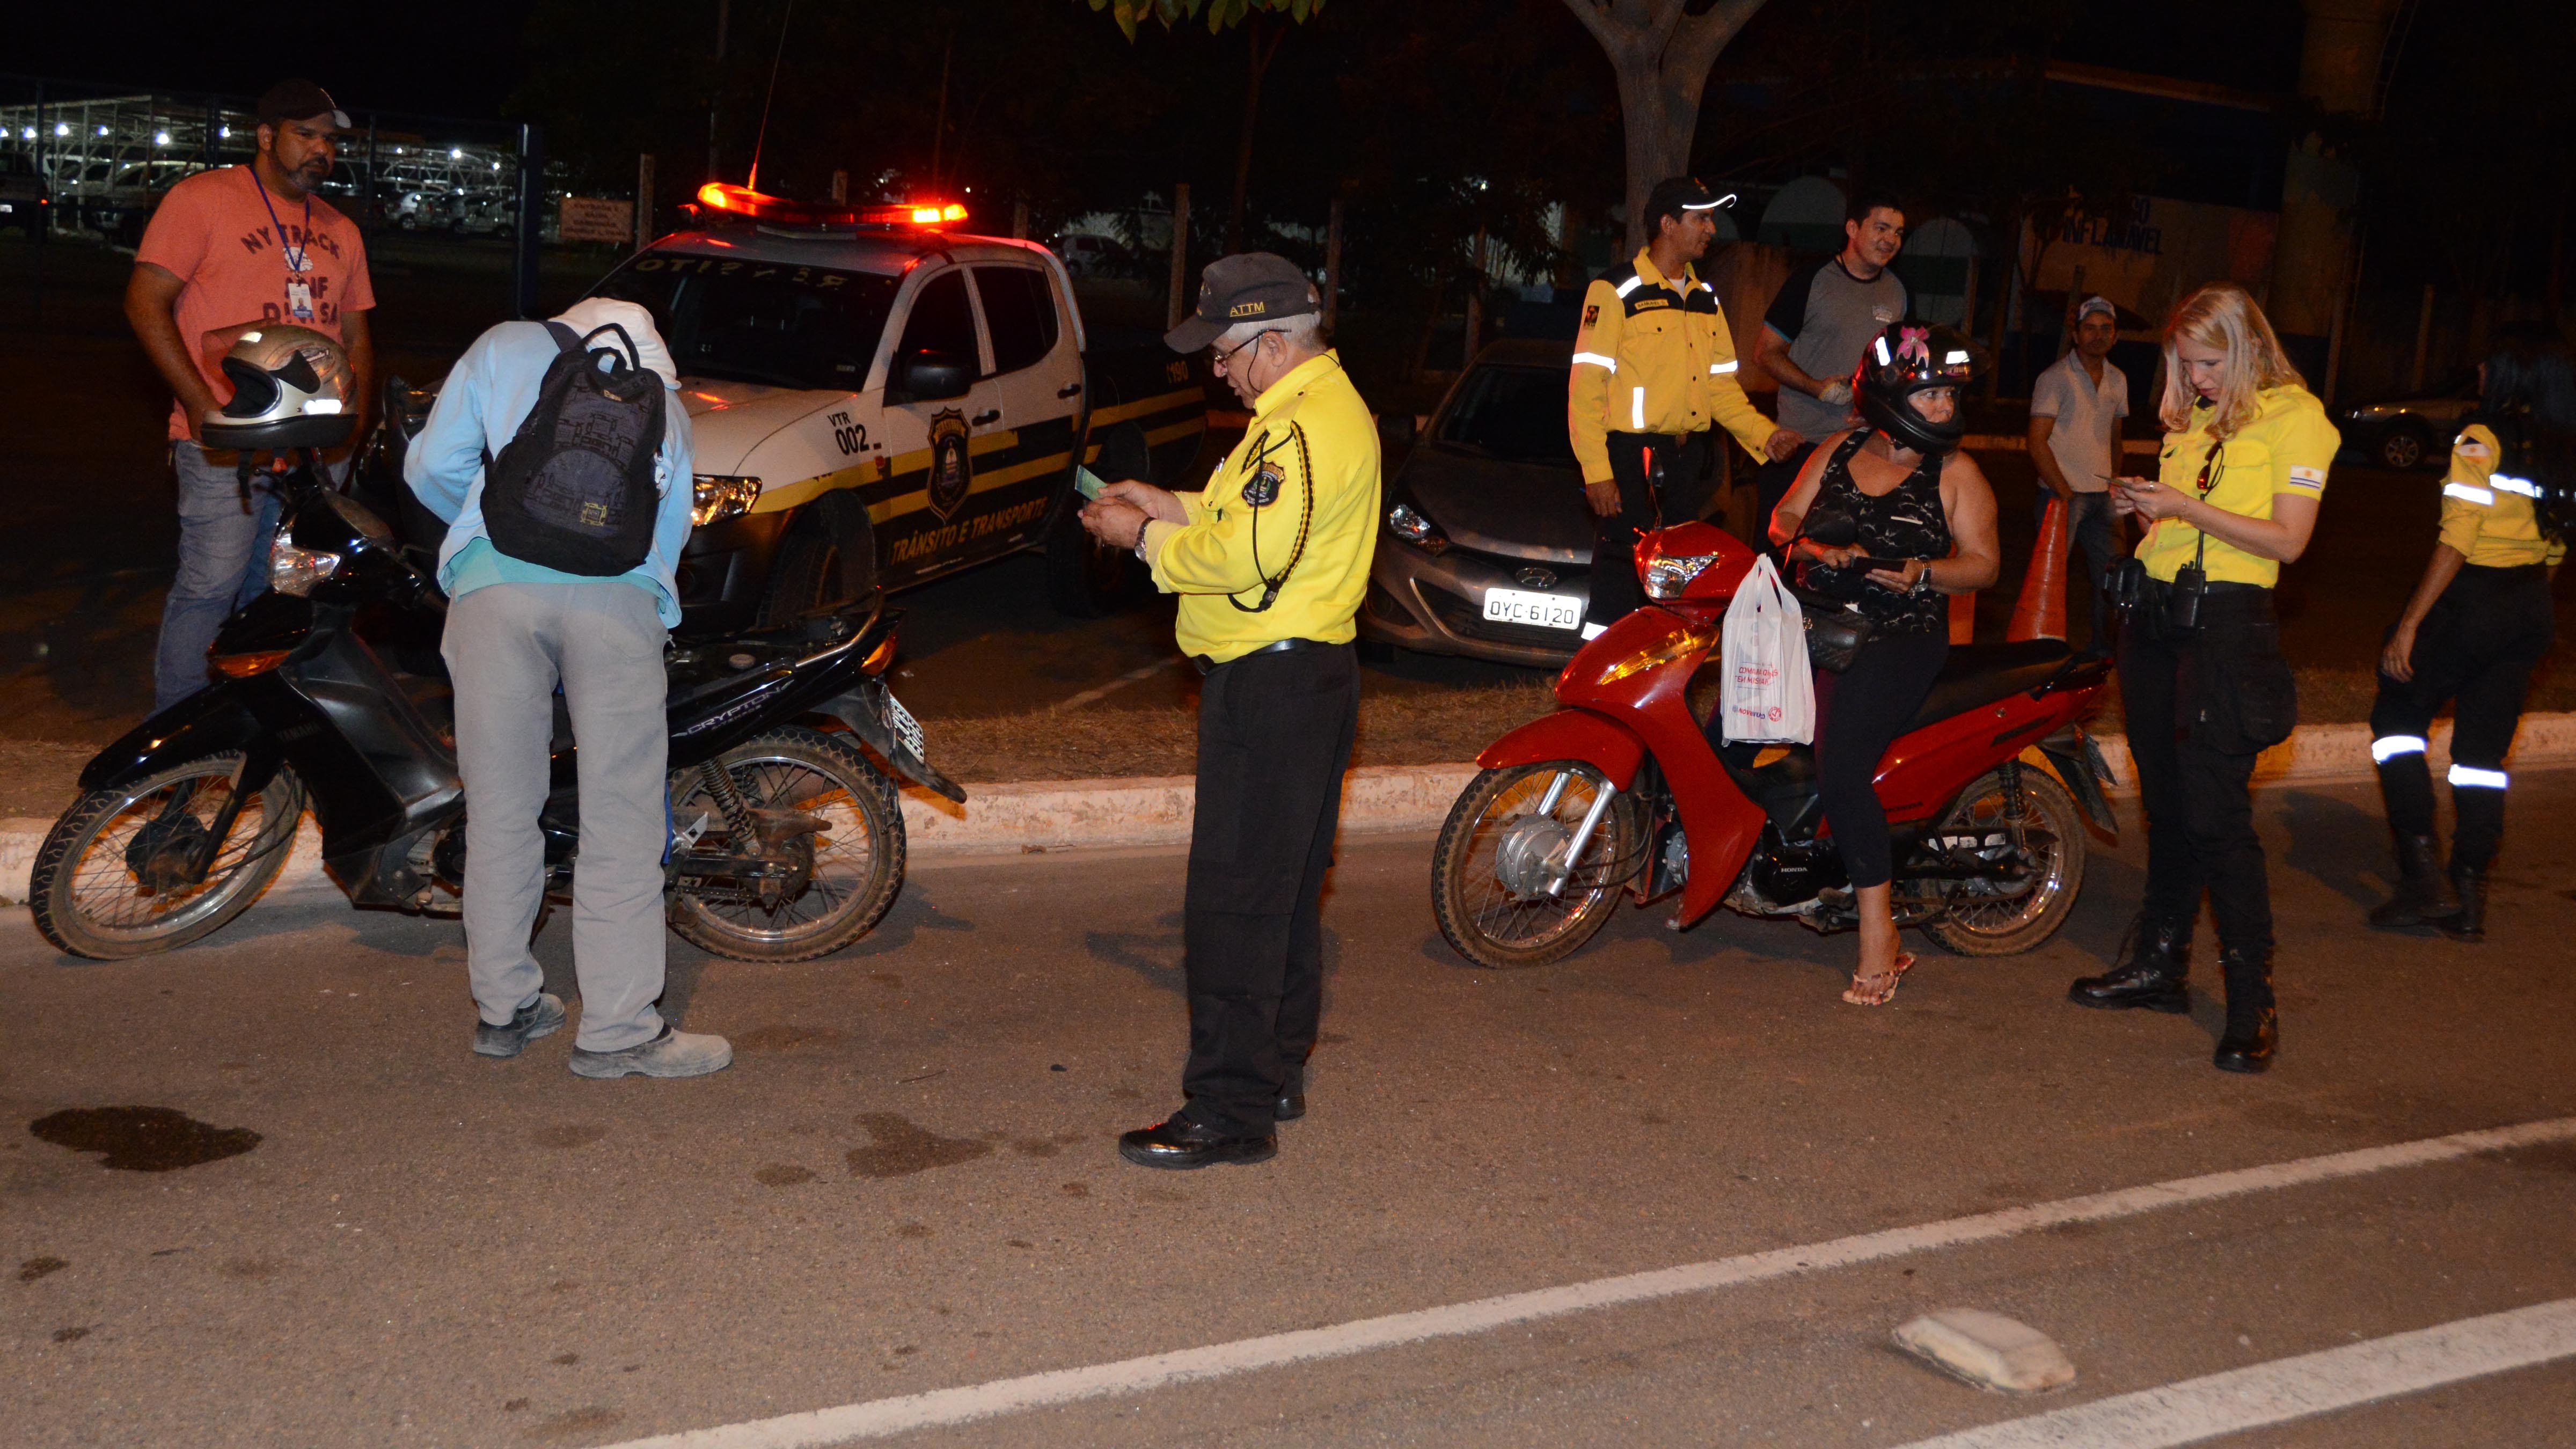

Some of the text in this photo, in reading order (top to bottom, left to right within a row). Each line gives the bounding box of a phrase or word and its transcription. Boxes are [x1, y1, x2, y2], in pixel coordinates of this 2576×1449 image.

[240, 224, 340, 260] NY TRACK
[1230, 301, 1265, 316] ATTM
[827, 412, 851, 427] VTR
[835, 424, 869, 456] 002
[891, 495, 1048, 566] TRÂNSITO E TRANSPORTE
[687, 687, 781, 735] CRYPTON
[276, 722, 321, 743] YAMAHA
